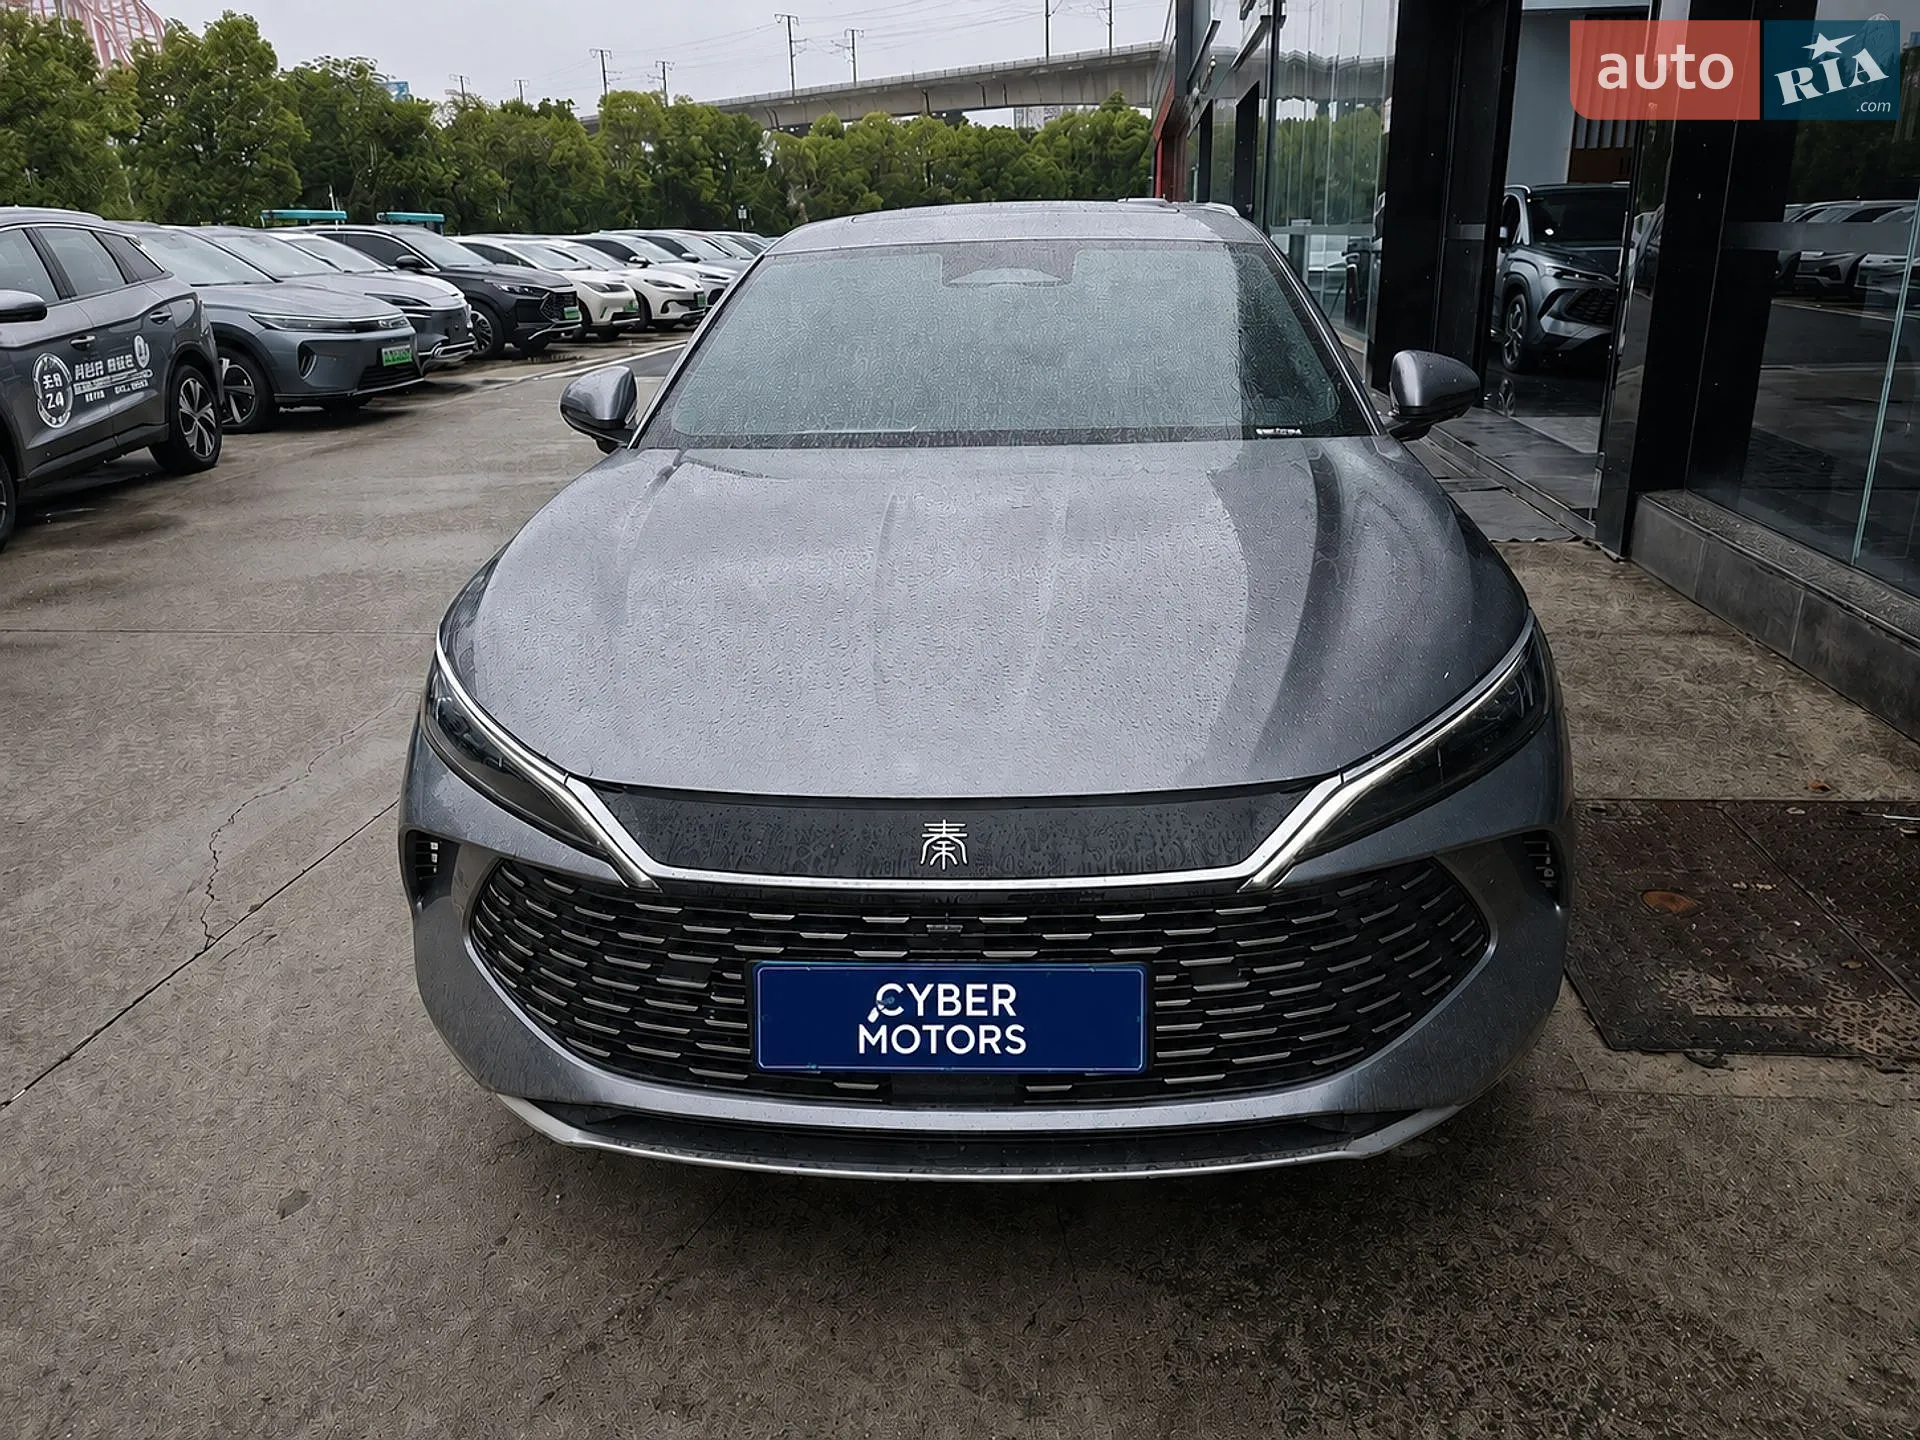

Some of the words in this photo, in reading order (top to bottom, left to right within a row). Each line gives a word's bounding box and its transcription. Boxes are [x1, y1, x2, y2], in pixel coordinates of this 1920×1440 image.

[920, 819, 968, 870] 秦
[873, 983, 1017, 1017] CYBER
[858, 1024, 1027, 1055] MOTORS
